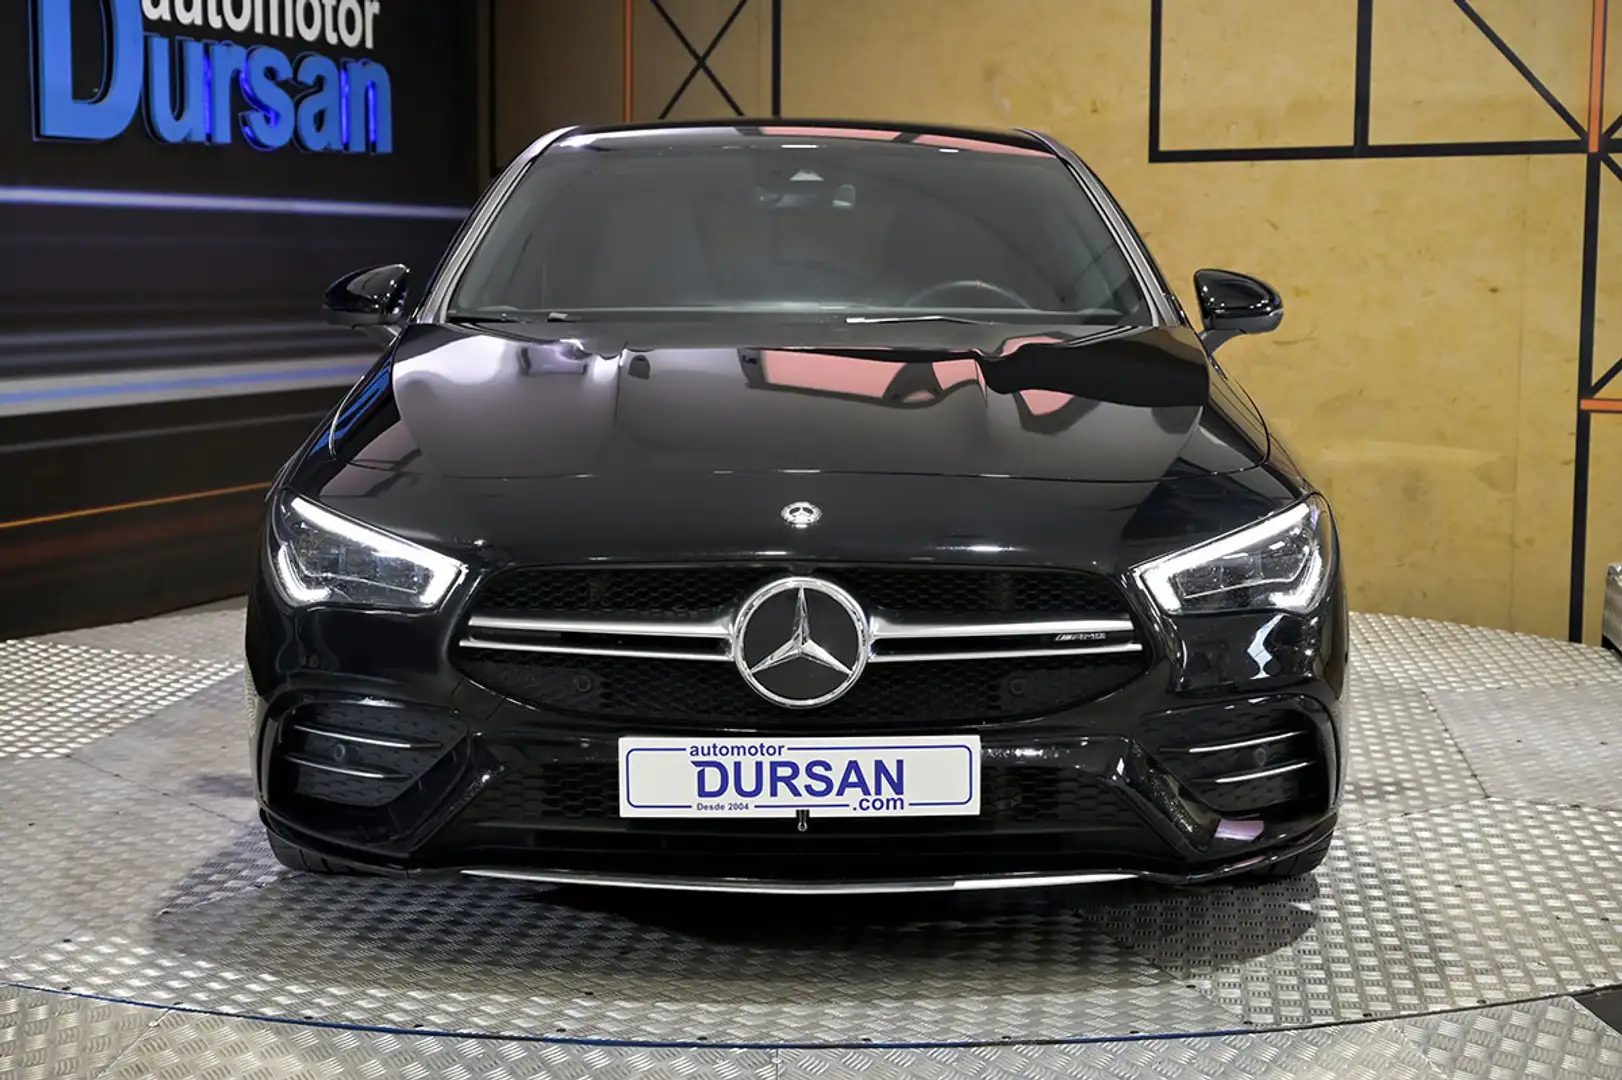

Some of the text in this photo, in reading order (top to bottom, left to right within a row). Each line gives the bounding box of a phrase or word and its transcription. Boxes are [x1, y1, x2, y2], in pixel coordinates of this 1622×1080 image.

[689, 742, 785, 757] automotor
[690, 758, 905, 799] DURSAN
[696, 802, 749, 811] Desde 2004
[852, 796, 905, 811] .com
